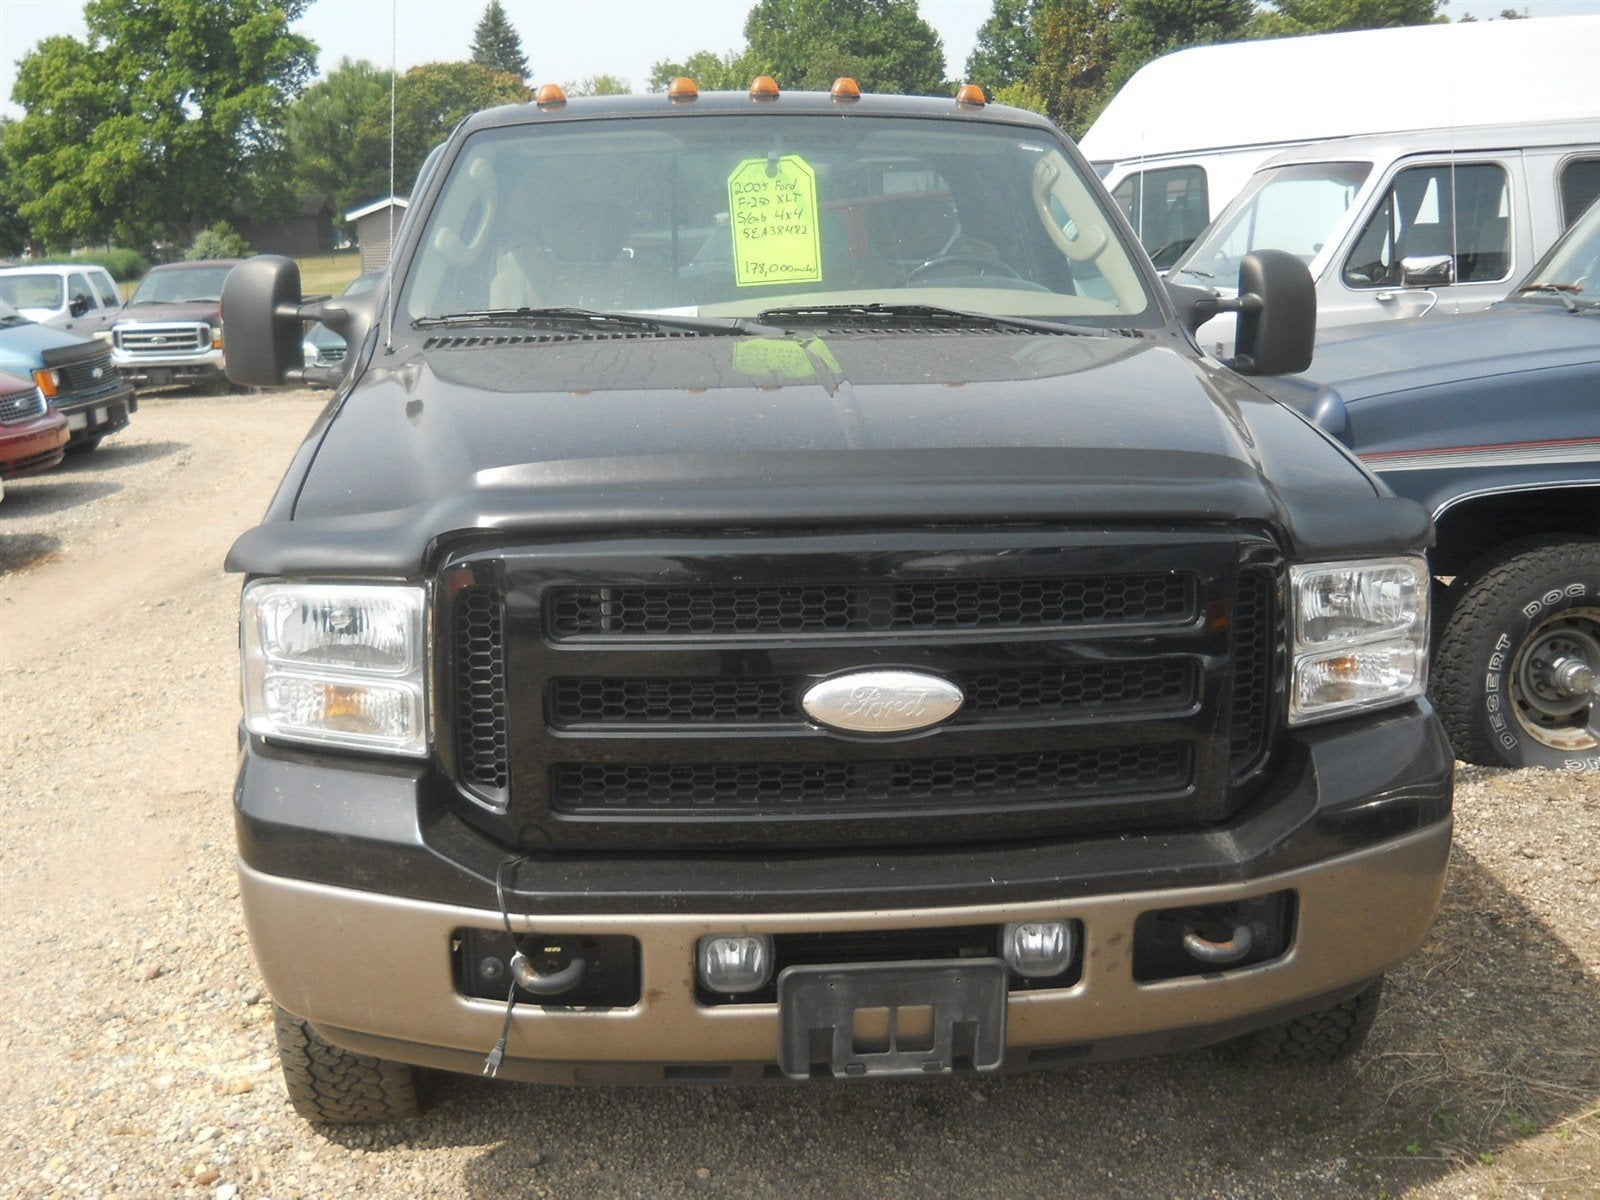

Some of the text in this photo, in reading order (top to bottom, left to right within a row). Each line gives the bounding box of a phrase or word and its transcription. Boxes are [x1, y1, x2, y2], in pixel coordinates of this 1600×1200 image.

[735, 178, 797, 195] 2005 Ford
[739, 193, 801, 208] F-250 XLT
[774, 208, 803, 220] 4x4
[1486, 633, 1518, 749] DESERT
[841, 686, 928, 718] Ford
